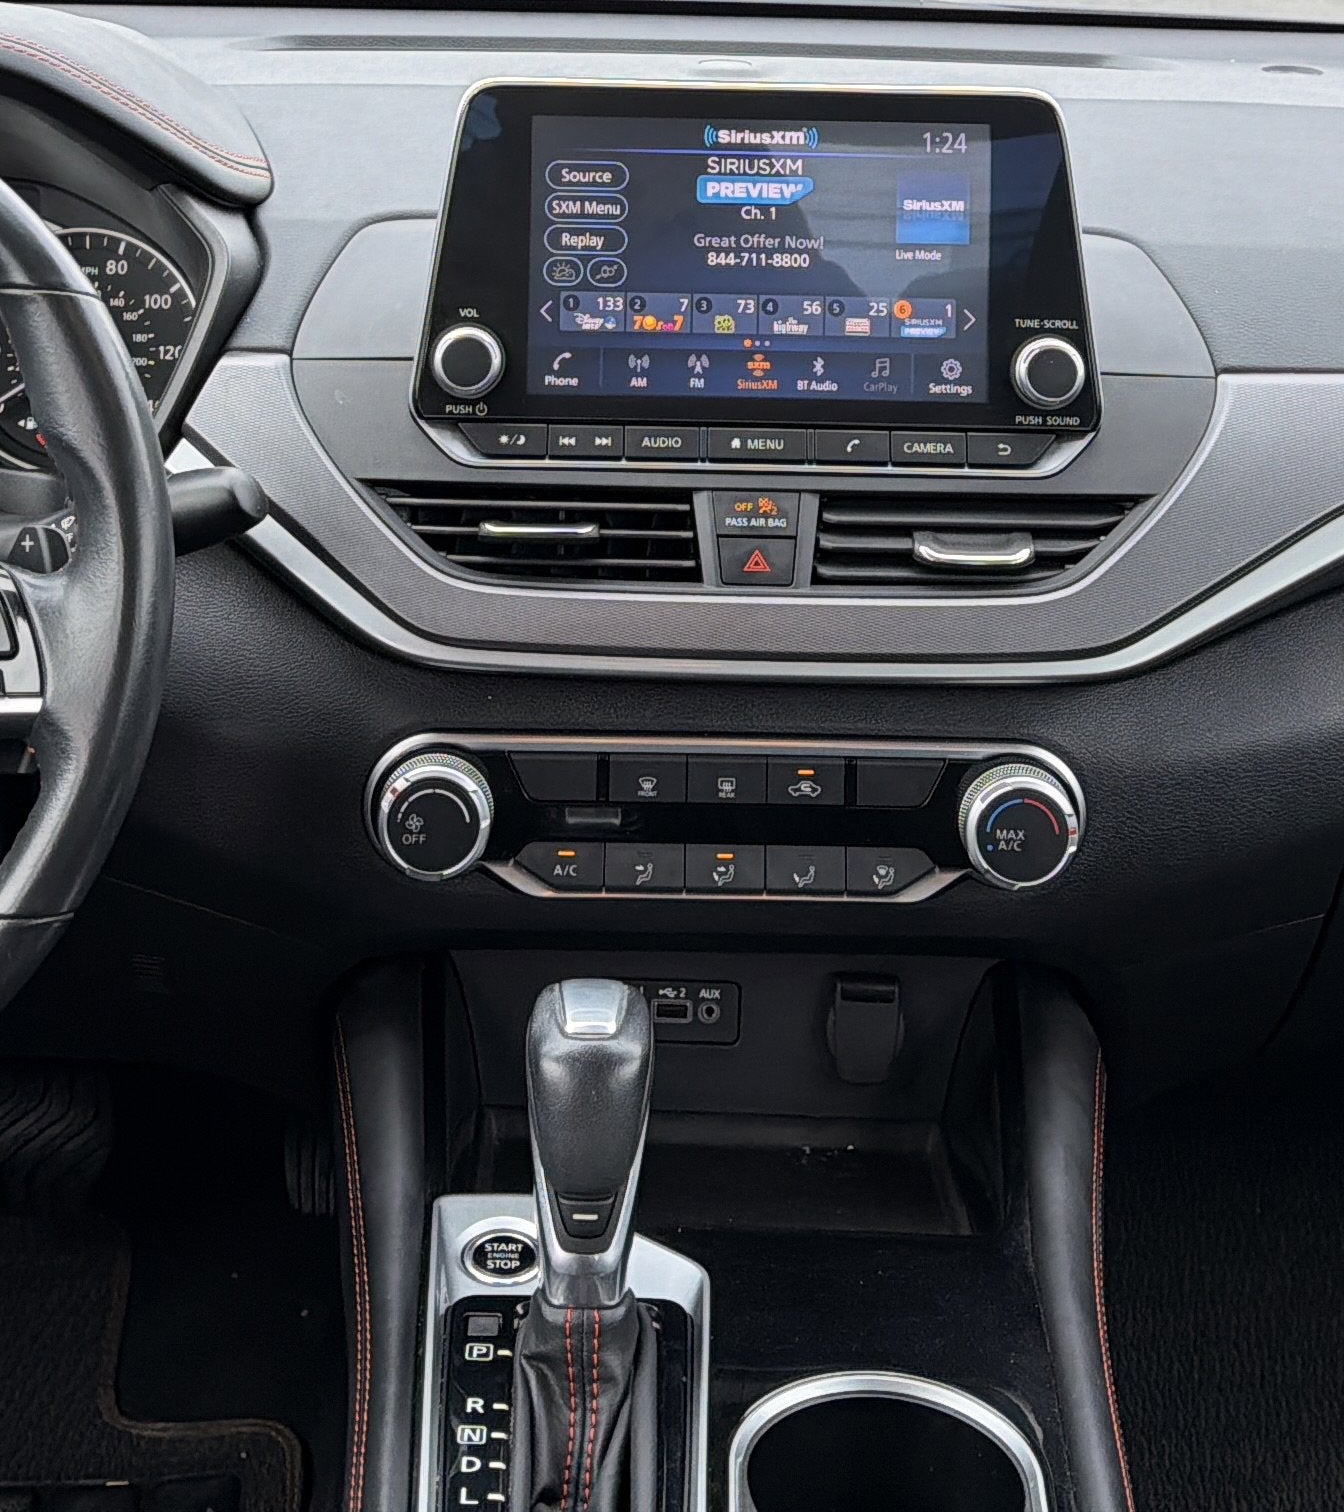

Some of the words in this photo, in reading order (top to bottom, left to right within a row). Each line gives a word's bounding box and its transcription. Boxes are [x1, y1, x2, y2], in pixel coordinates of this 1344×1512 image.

[922, 132, 968, 154] 1:24
[707, 157, 803, 175] SIRIUSXM
[561, 168, 613, 183] Source
[707, 182, 803, 199] PREVIEW
[552, 200, 581, 215] SXM
[584, 201, 621, 216] Menu
[902, 199, 965, 212] SiriusXM
[741, 206, 765, 220] Ch.
[769, 207, 776, 220] 1
[561, 232, 605, 250] Replay
[694, 233, 737, 249] Great
[740, 234, 781, 249] Offer
[785, 236, 825, 250] Now!
[707, 251, 810, 268] 844-711-8800
[896, 249, 913, 261] Live
[914, 250, 942, 261] Mode
[106, 260, 128, 275] 80
[109, 297, 125, 307] 140
[144, 294, 172, 309] 100
[567, 298, 574, 308] 1
[597, 296, 624, 311] 133
[634, 299, 641, 310] 2
[679, 299, 689, 312] 7
[700, 299, 708, 310] 3
[737, 299, 755, 313] 73
[766, 301, 774, 311] 4
[459, 308, 480, 318] VOL
[803, 301, 822, 315] 56
[832, 303, 840, 313] 5
[869, 303, 888, 316] 25
[899, 304, 907, 314] 6
[945, 304, 952, 318] 1
[122, 311, 138, 321] 160
[132, 334, 147, 342] 180
[544, 375, 579, 387] Phone
[630, 376, 647, 388] AM
[689, 377, 705, 388] FM
[737, 378, 778, 390] SiriusXM
[796, 380, 808, 390] BT
[810, 381, 838, 392] Audio
[864, 382, 898, 394] CarPlay
[928, 382, 973, 397] Settings
[446, 403, 473, 414] PUSH
[1015, 415, 1043, 425] PUSH
[1046, 416, 1081, 426] SOUND
[641, 437, 682, 449] AUDIO
[746, 438, 784, 451] MENU
[903, 442, 954, 454] CAMERA
[734, 502, 754, 512] OFF
[725, 517, 748, 527] PASS
[750, 517, 766, 527] AIR
[767, 518, 787, 528] BAG
[401, 833, 427, 845] OFF
[996, 828, 1025, 840] MAX
[997, 840, 1022, 852] A/C
[553, 864, 578, 876] A/C
[679, 987, 687, 998] 2
[699, 988, 721, 1000] AUX
[484, 1242, 524, 1252] START
[486, 1259, 521, 1270] STOP
[472, 1345, 488, 1358] P
[465, 1397, 485, 1414] R
[464, 1427, 481, 1441] N
[460, 1455, 482, 1473] D
[459, 1487, 480, 1505] L
